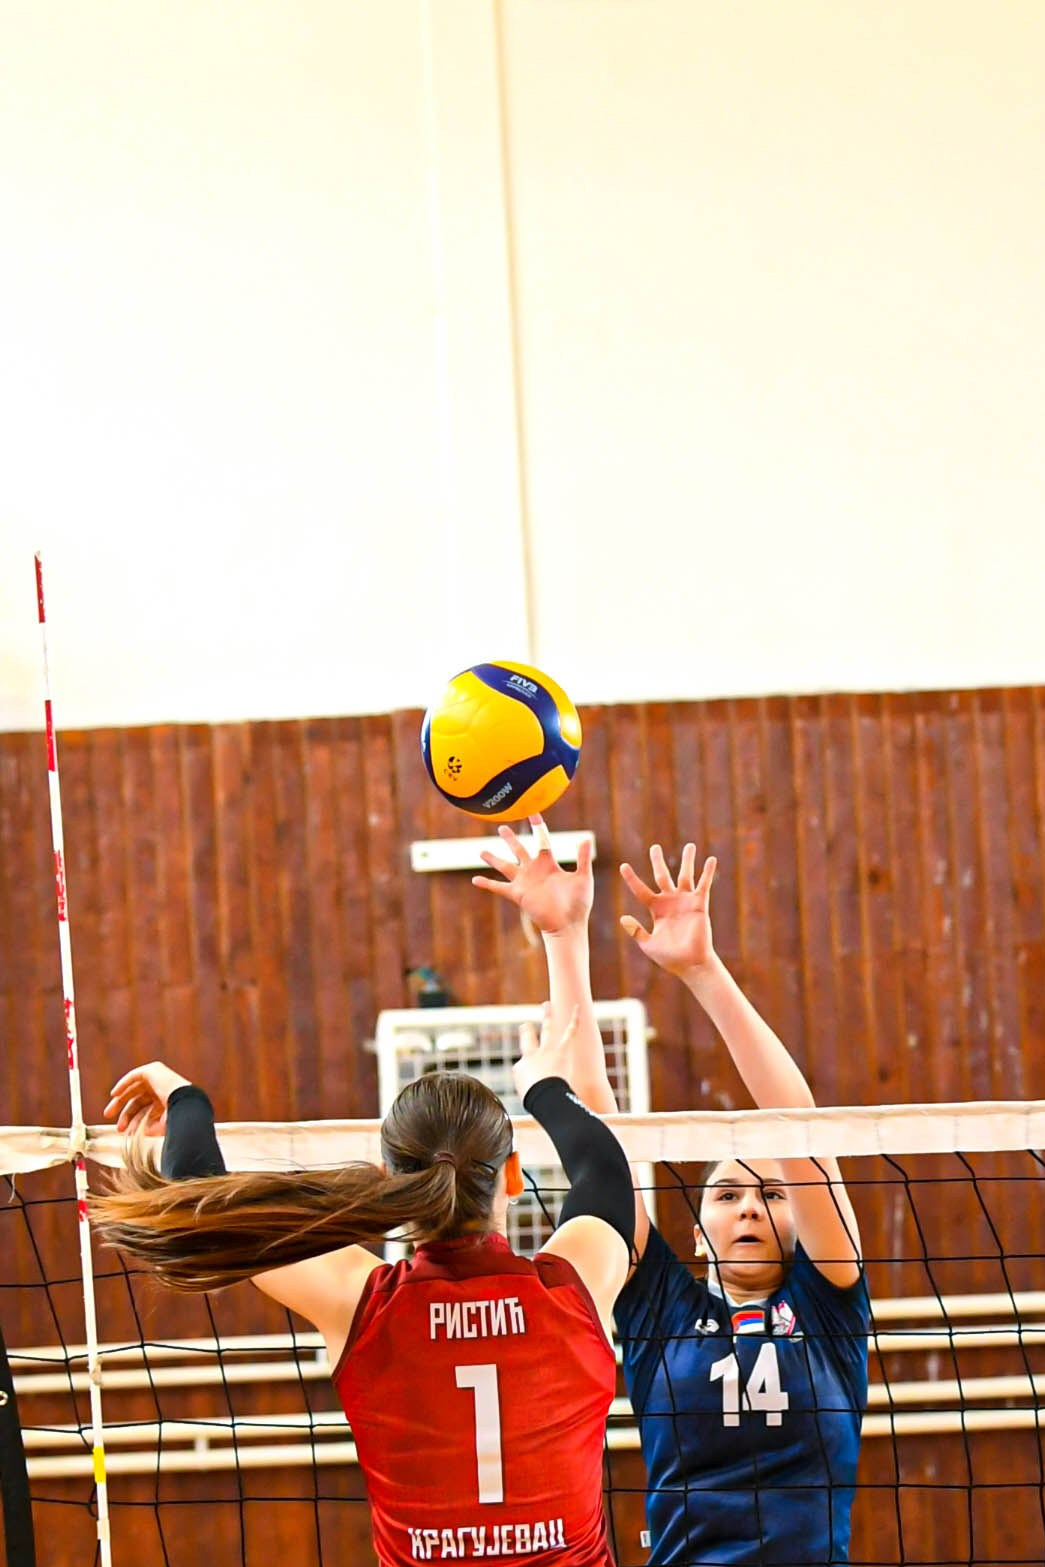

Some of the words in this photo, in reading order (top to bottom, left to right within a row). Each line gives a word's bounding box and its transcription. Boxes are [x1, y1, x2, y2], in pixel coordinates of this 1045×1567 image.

[510, 674, 538, 693] FIVB
[481, 781, 513, 808] V200W
[429, 1296, 526, 1340] РИСТИЋ
[710, 1342, 789, 1427] 14
[455, 1363, 504, 1504] 1
[408, 1518, 568, 1560] КРАГУЈЕВАЦ
